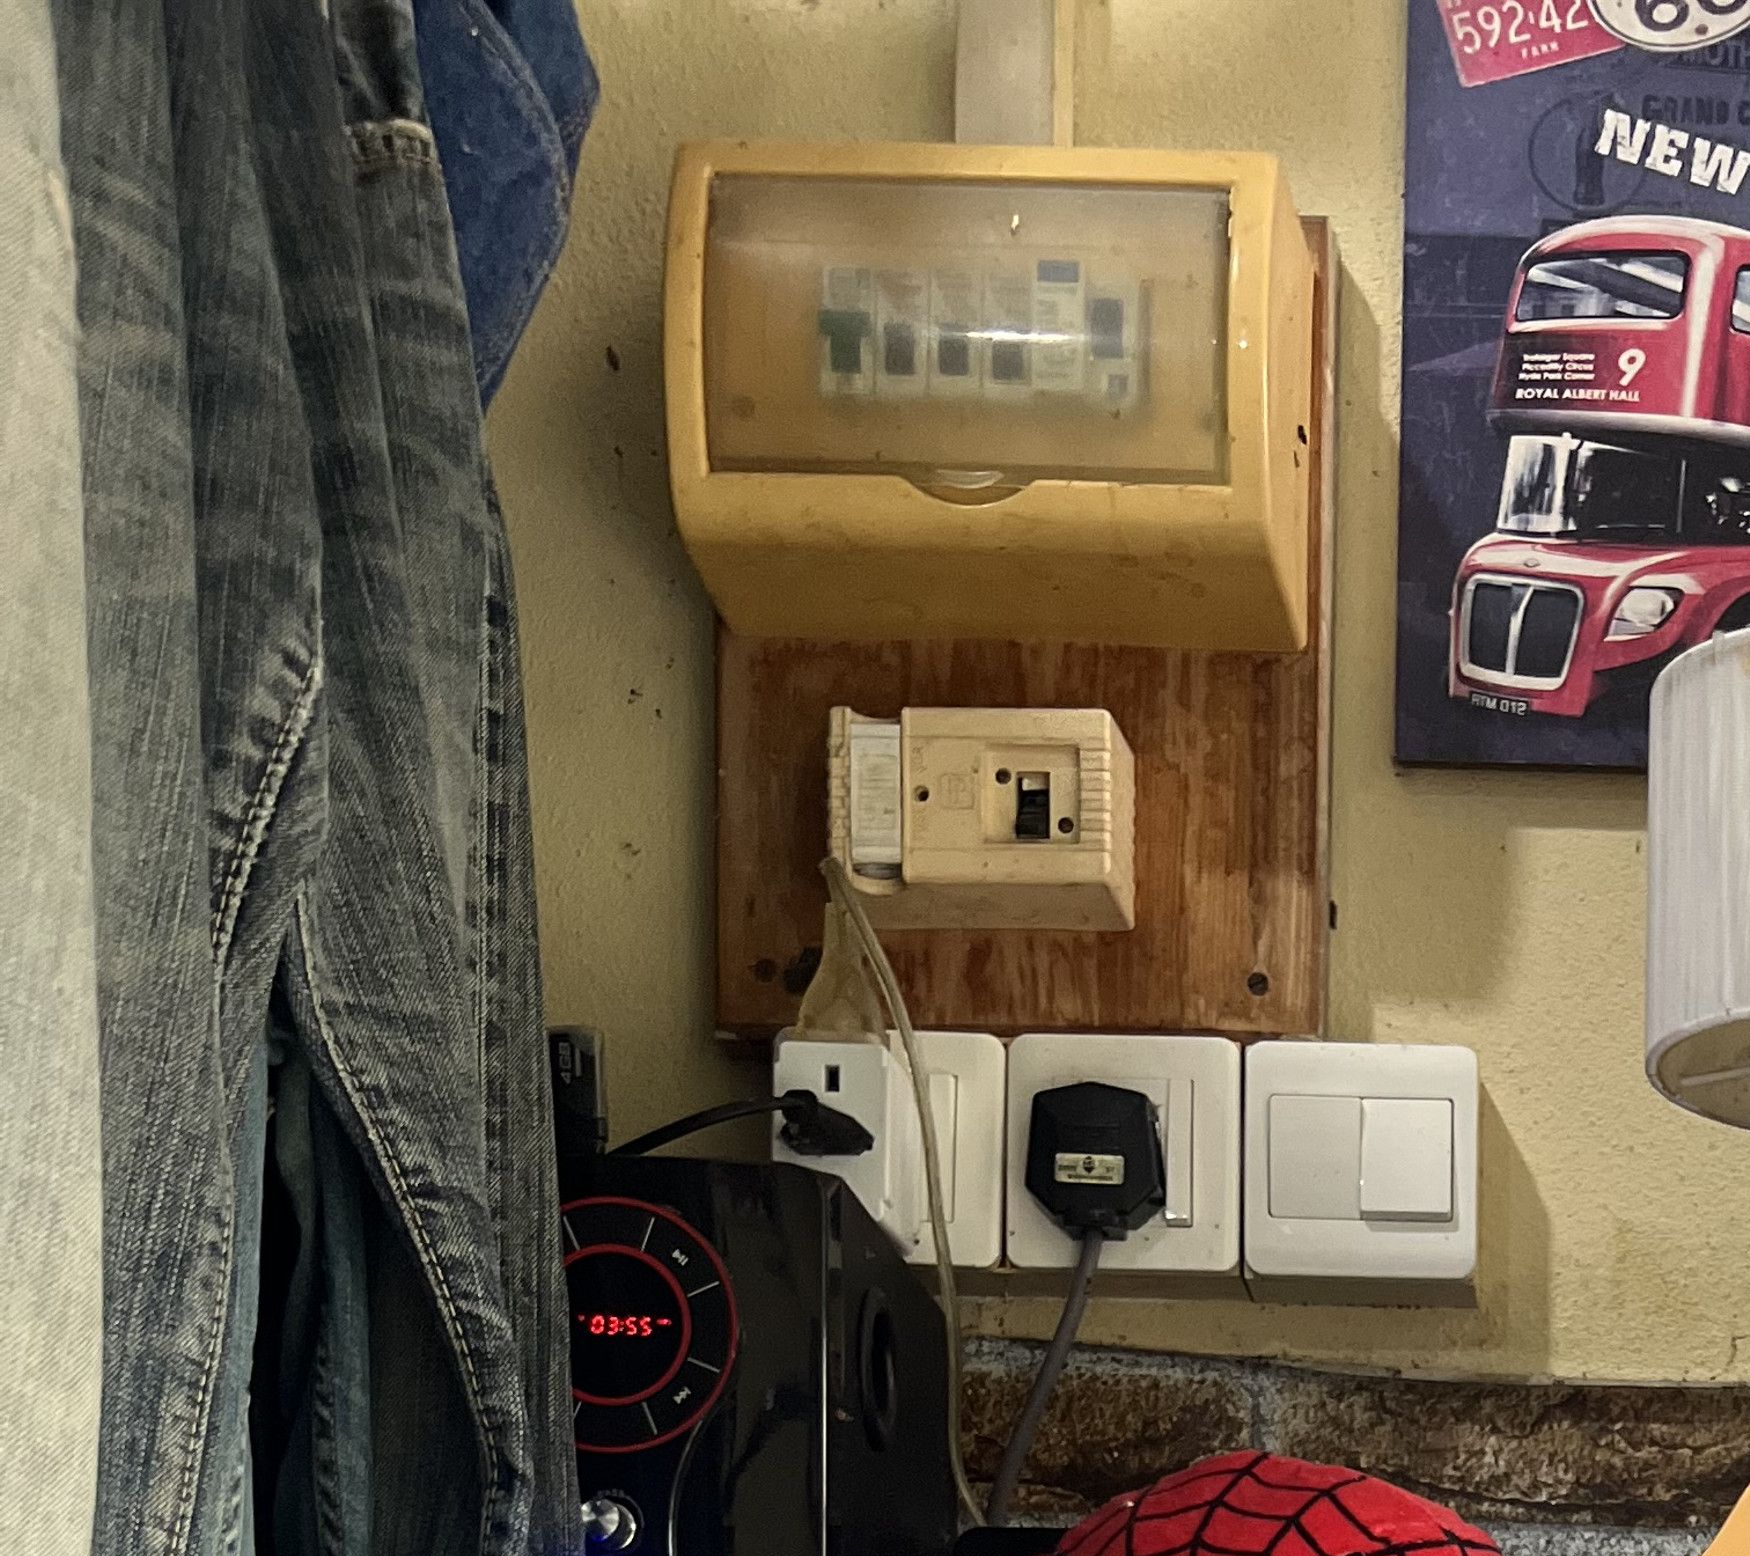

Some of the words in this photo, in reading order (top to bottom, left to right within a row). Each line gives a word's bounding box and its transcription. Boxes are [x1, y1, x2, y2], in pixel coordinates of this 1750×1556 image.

[1618, 348, 1646, 386] 9
[1515, 388, 1559, 399] ROYAL
[1562, 388, 1607, 400] ALBERT
[1609, 390, 1640, 402] HALL
[590, 1314, 652, 1337] 03:55
